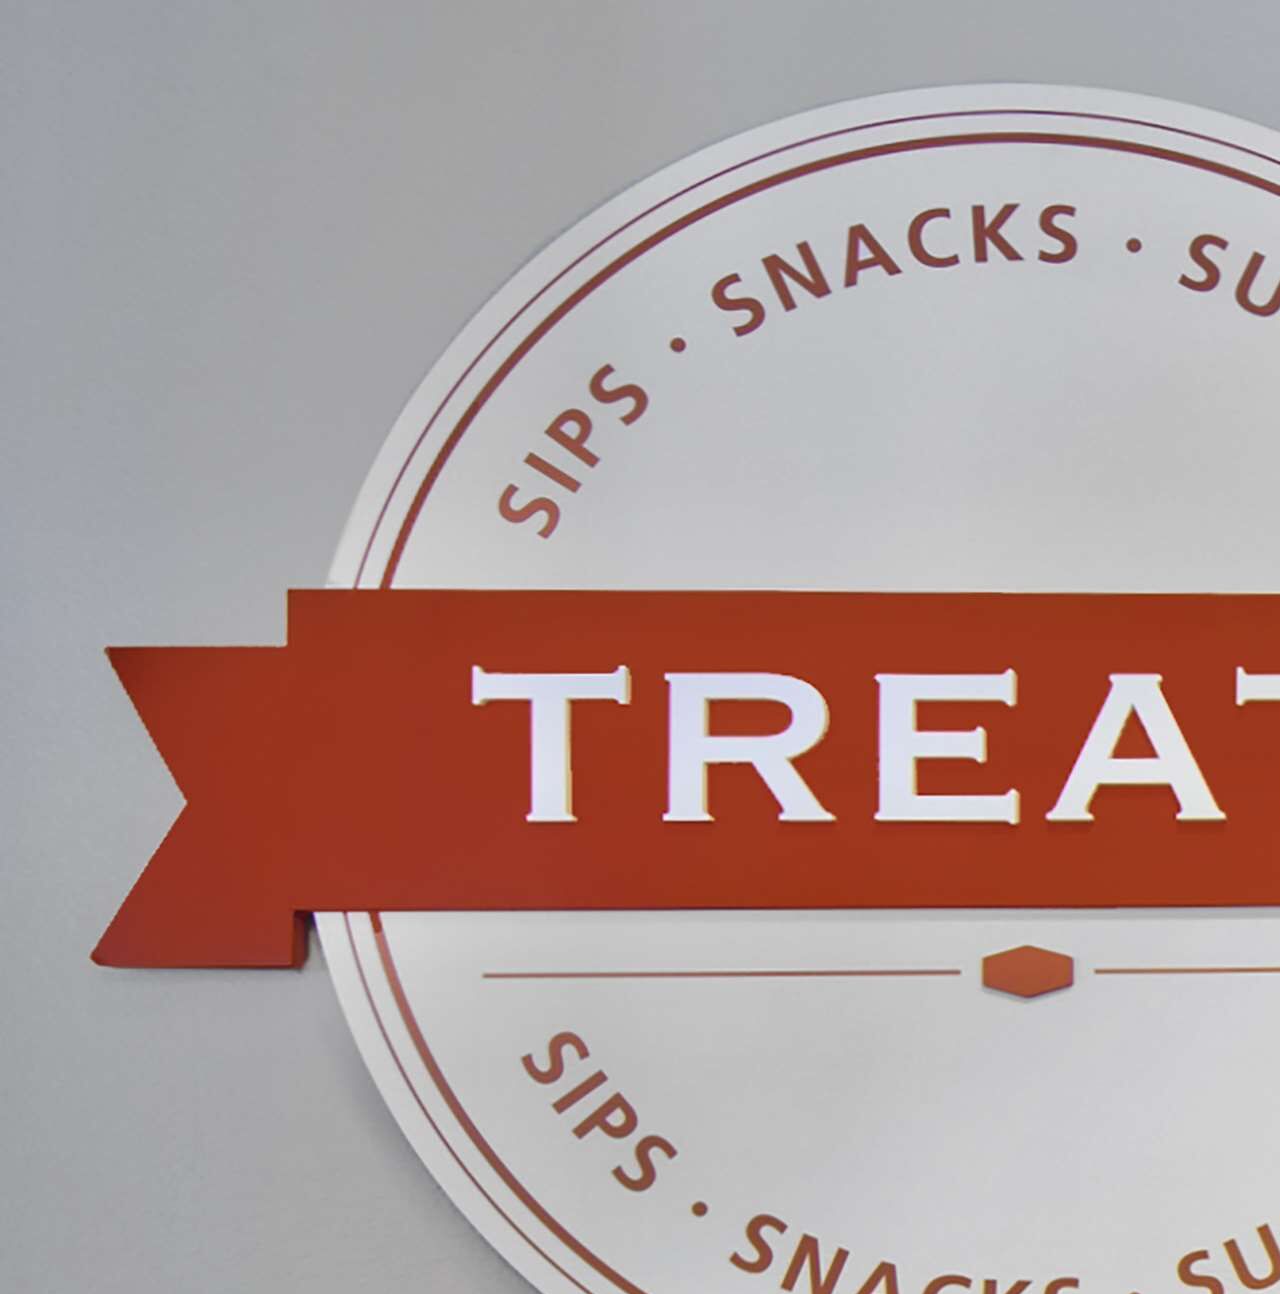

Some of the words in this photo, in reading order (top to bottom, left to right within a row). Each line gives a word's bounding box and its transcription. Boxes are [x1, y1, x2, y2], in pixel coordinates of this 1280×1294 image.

[498, 367, 646, 538] SIPS
[713, 204, 1074, 333] SNACKS
[522, 1033, 675, 1190] SIPS
